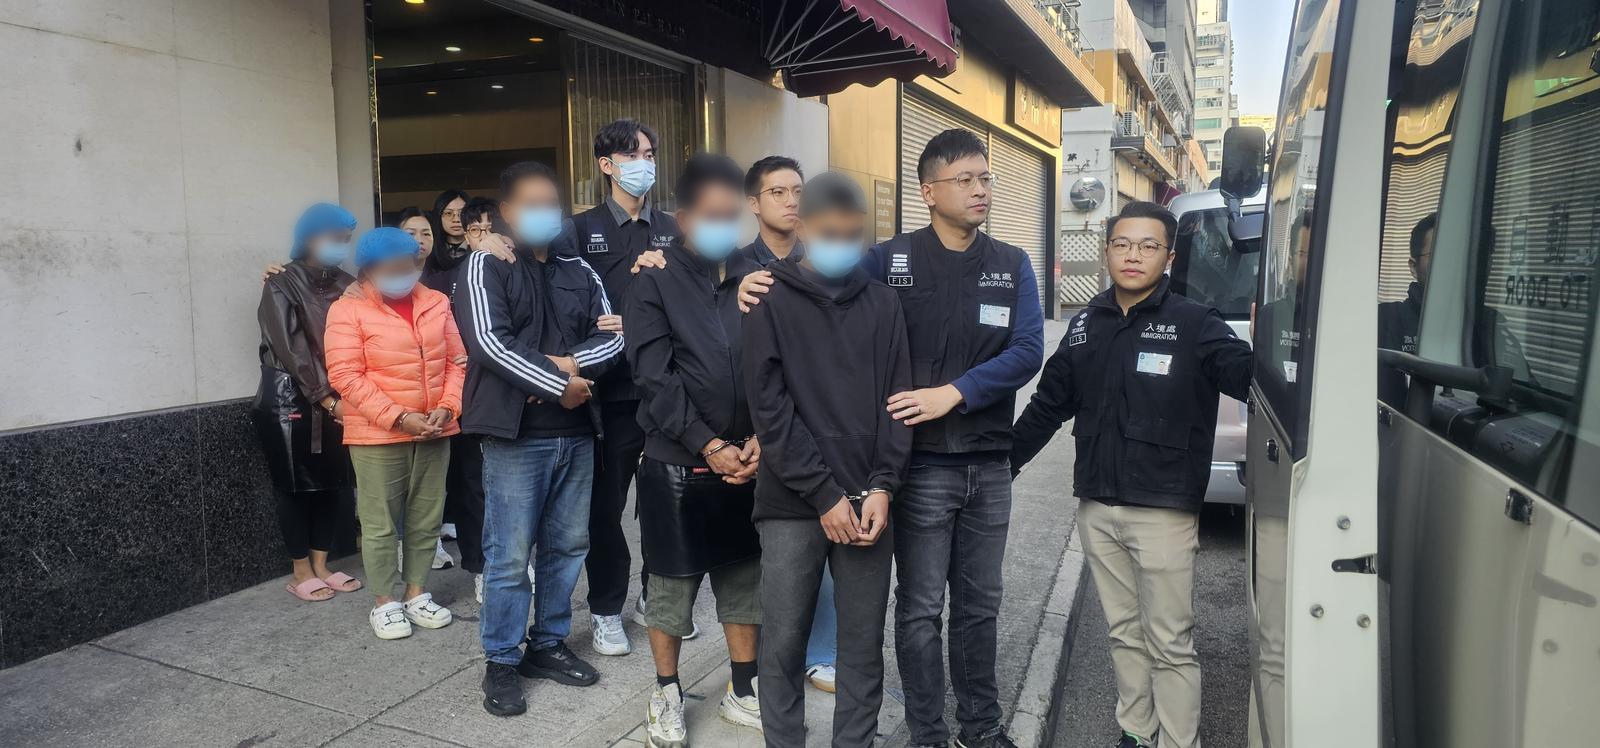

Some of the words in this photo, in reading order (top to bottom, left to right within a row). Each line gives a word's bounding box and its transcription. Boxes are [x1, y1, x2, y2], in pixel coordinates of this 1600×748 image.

[892, 277, 908, 285] FIS
[980, 272, 1012, 281] 入境處
[977, 280, 1015, 289] IMMIGRATION
[1144, 322, 1177, 333] 入境處
[1140, 332, 1178, 341] IMMIGRATION
